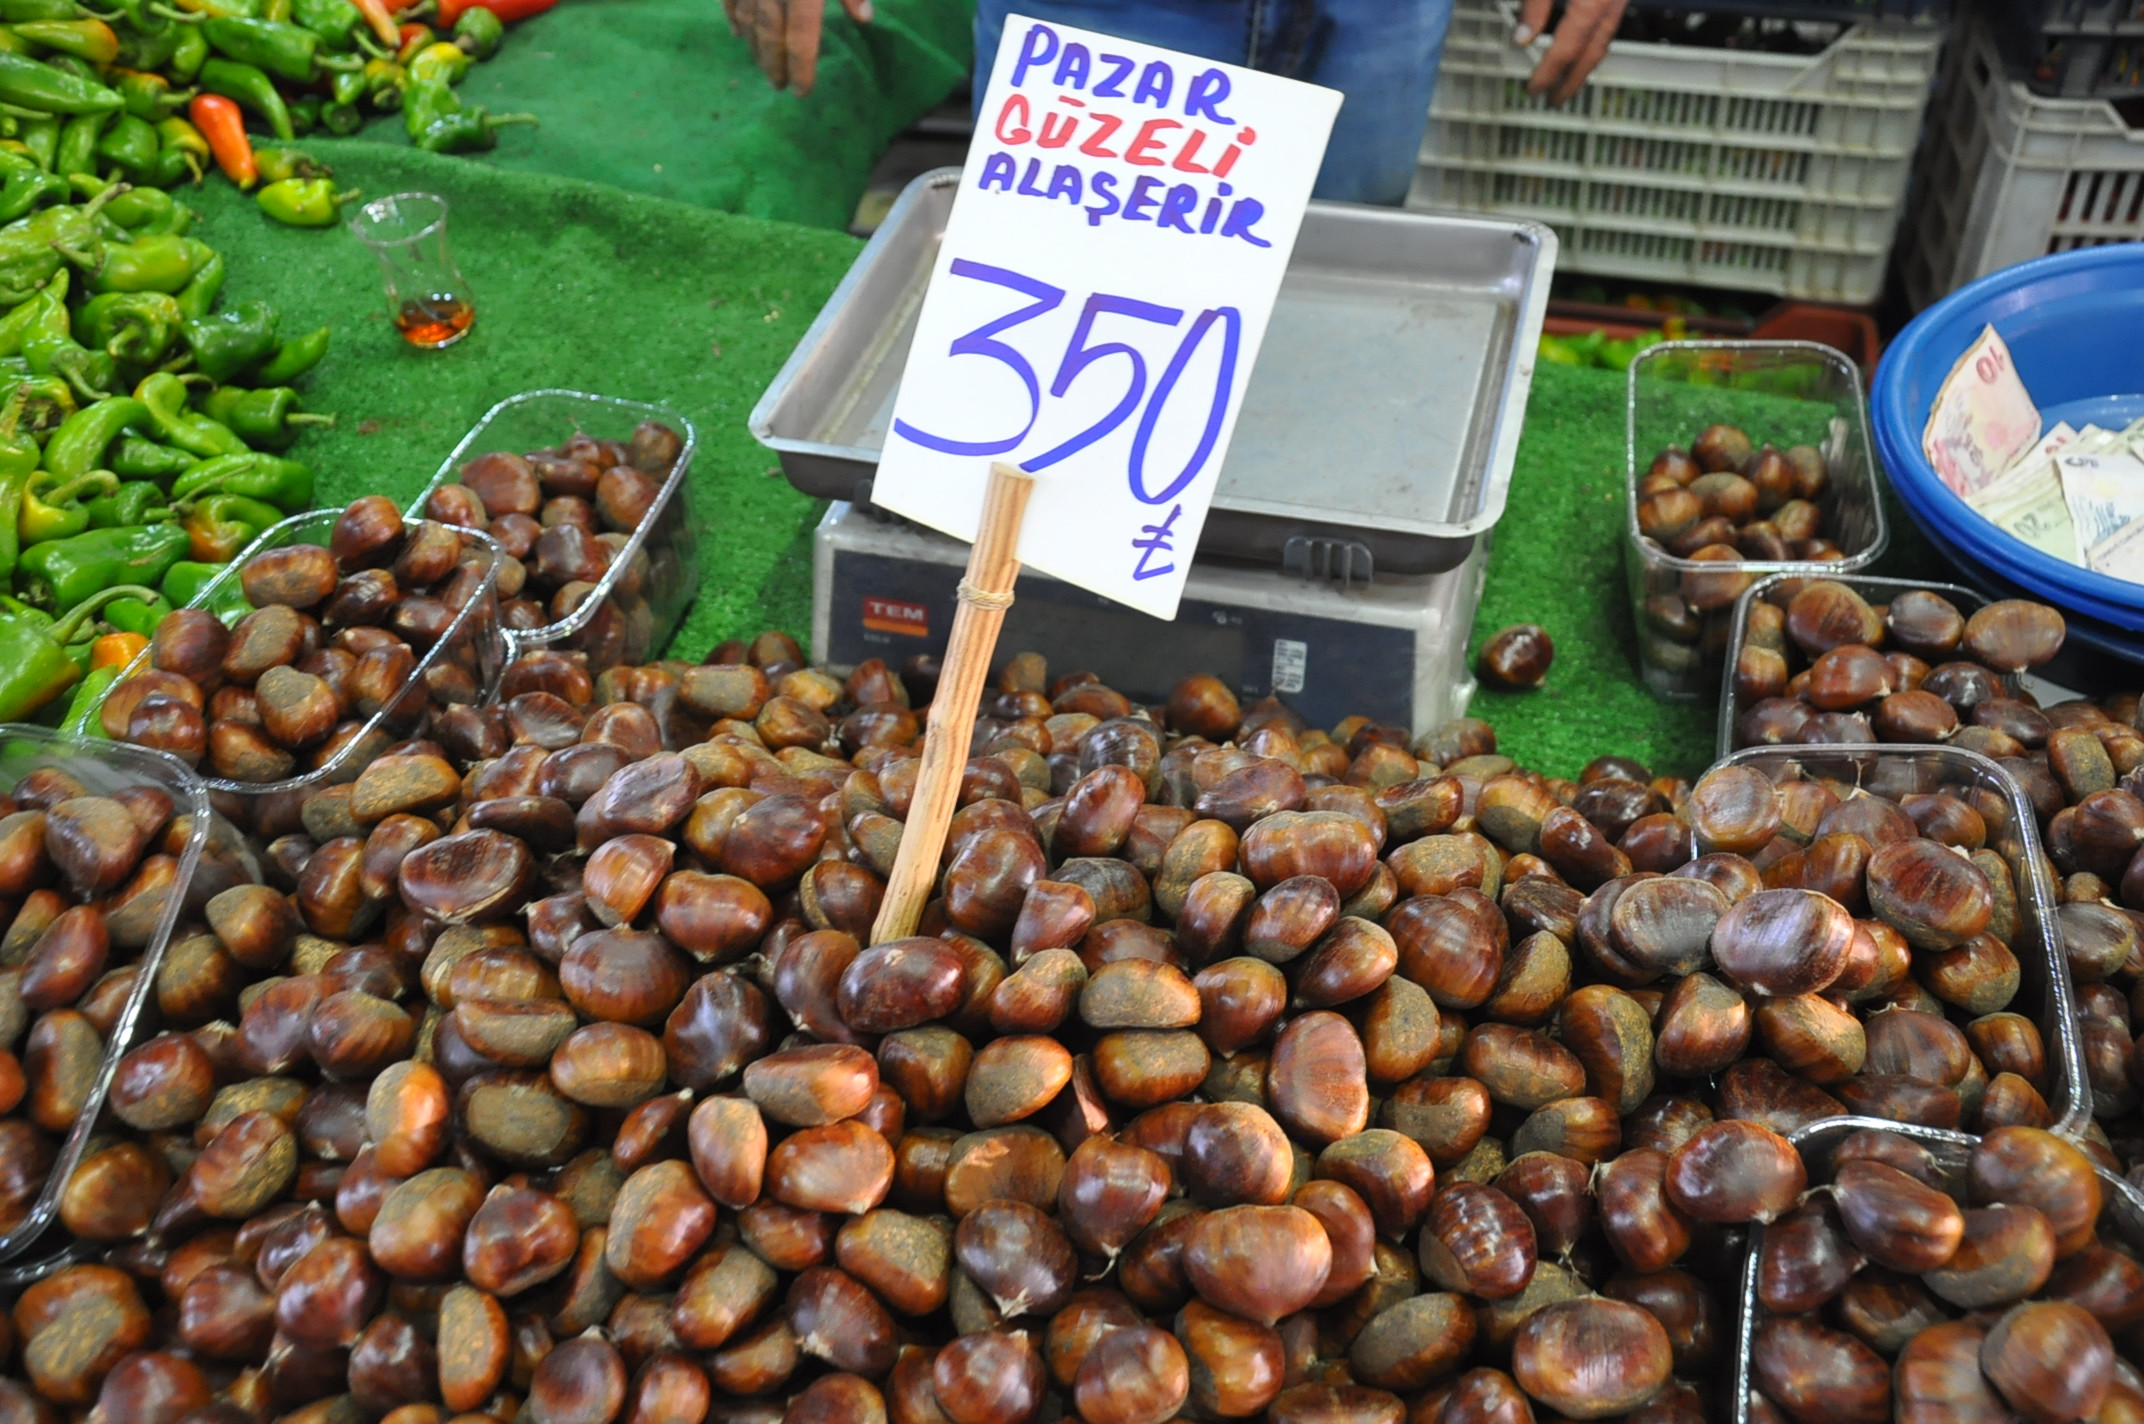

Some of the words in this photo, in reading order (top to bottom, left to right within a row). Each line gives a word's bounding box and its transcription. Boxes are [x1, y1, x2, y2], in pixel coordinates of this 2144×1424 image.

[1011, 24, 1236, 125] PAZAR
[995, 94, 1256, 178] GÜZELİ
[894, 258, 1241, 504] 350
[1976, 345, 2005, 385] 10
[868, 601, 924, 621] TEM
